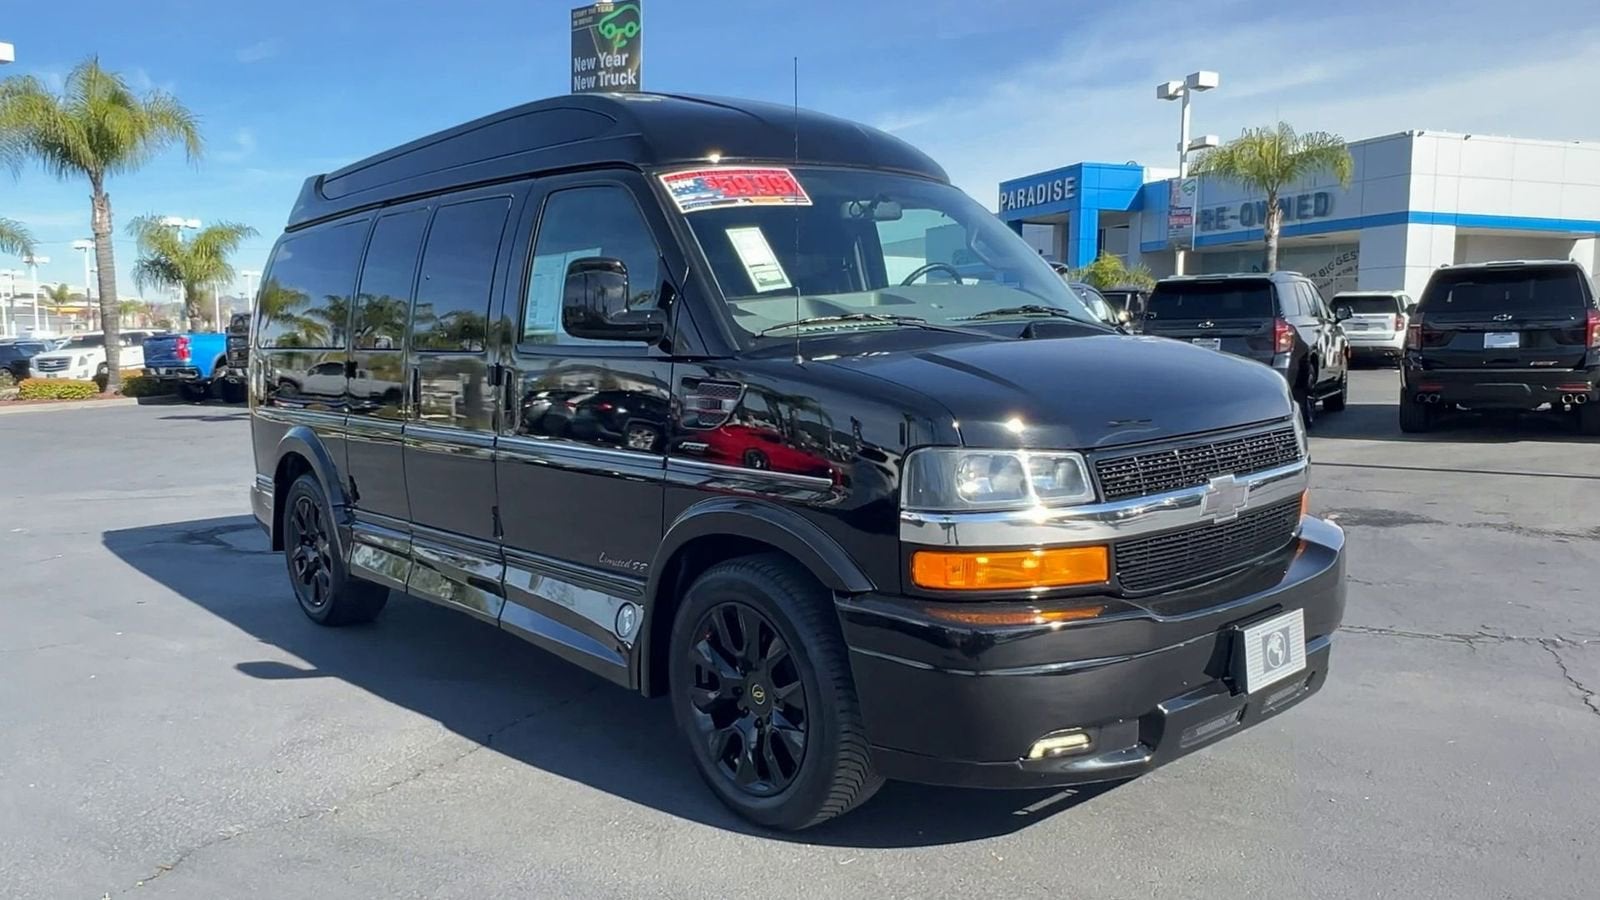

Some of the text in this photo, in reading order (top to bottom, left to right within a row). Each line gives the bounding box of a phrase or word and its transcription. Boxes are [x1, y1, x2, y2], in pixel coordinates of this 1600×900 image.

[597, 4, 615, 13] YEAR
[574, 51, 629, 73] New Year
[574, 68, 637, 91] New Truck
[1000, 176, 1076, 211] PARADISE
[1200, 191, 1332, 232] RE-OWNED
[1318, 249, 1359, 277] BIGGES
[598, 551, 633, 569] Limited
